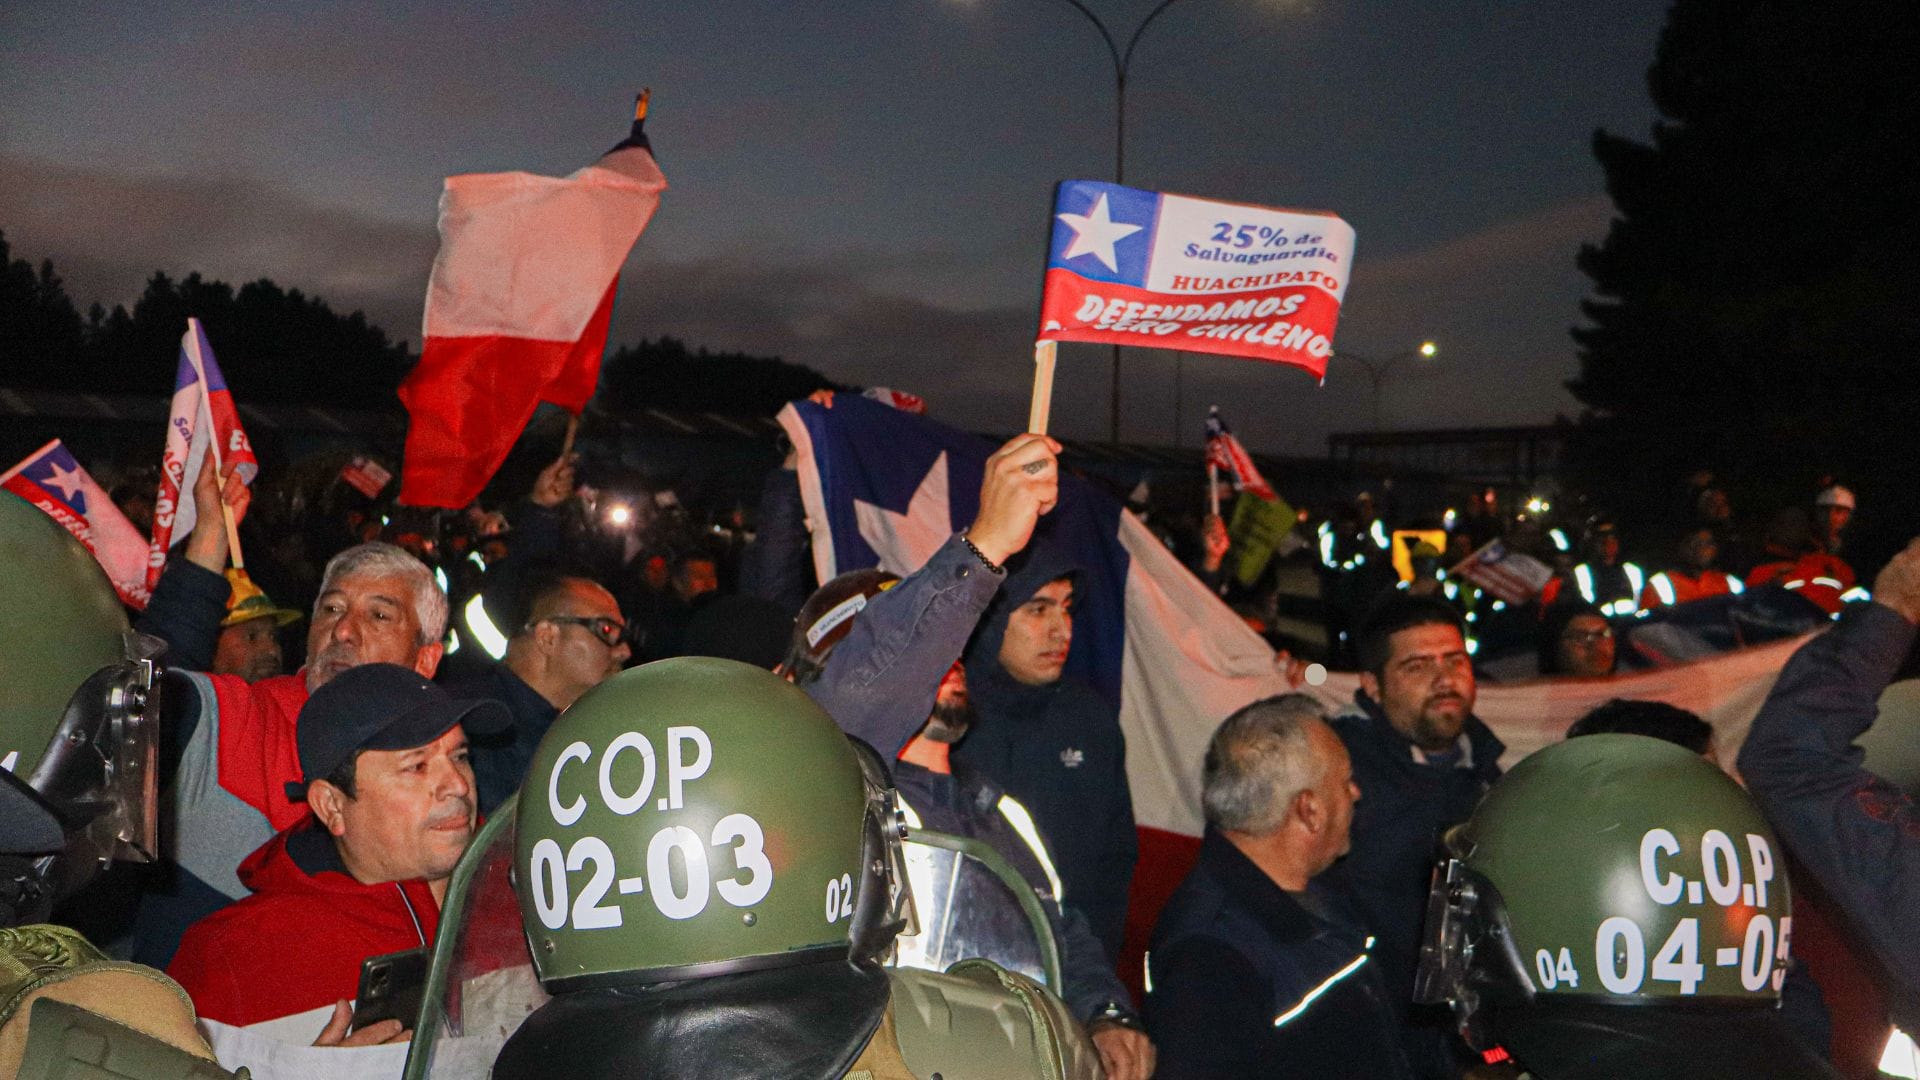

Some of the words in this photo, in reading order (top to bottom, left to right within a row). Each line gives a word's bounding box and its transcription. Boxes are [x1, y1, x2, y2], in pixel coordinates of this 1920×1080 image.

[1183, 242, 1339, 265] Salvaguardia
[1210, 221, 1289, 249] 25%
[1294, 233, 1324, 246] de
[1171, 270, 1338, 291] HUACHIPATO
[1075, 293, 1306, 323] DEFENDAMOS
[1187, 310, 1332, 358] CHILENO
[530, 813, 774, 930] 02-03
[1639, 827, 1775, 908] C.O.P
[825, 872, 853, 924] 02
[1535, 946, 1579, 990] 04
